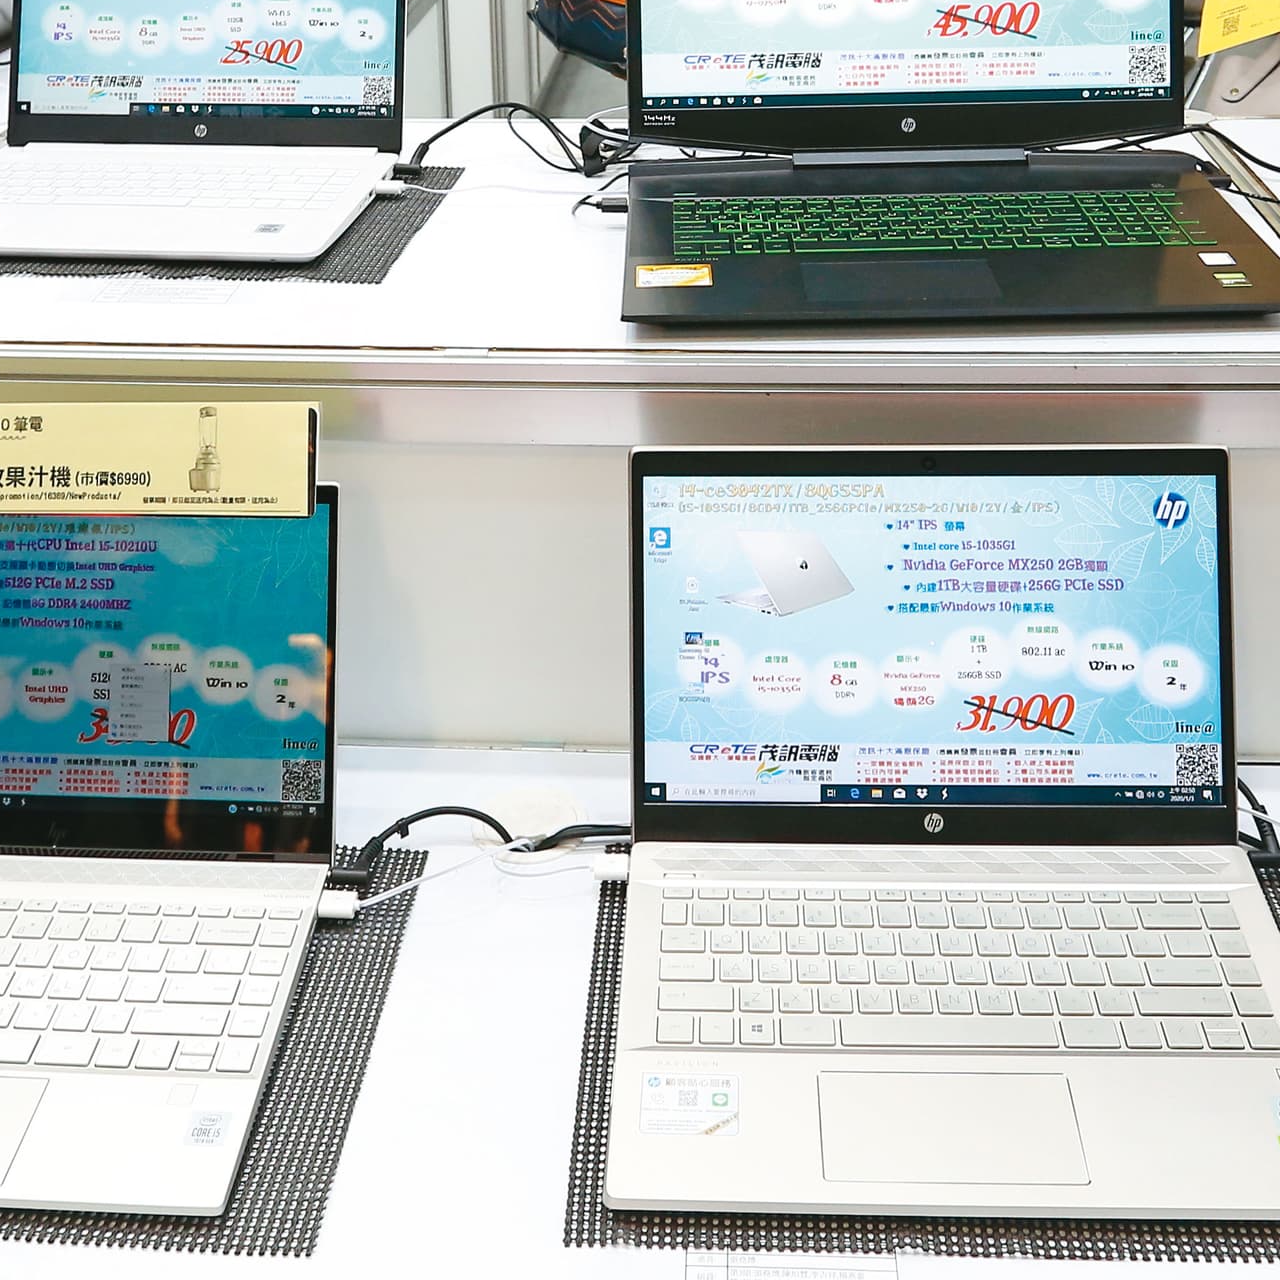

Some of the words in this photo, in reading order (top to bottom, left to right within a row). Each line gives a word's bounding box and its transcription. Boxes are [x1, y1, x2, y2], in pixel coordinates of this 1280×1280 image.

[1130, 30, 1165, 41] line@
[747, 52, 823, 69] 茂訊電腦
[194, 124, 208, 138] hp
[901, 118, 916, 132] hp
[13, 416, 44, 433] 筆電
[74, 470, 152, 489] (市價$6990)
[1153, 491, 1190, 530] hp
[918, 520, 937, 531] IPS
[64, 540, 95, 551] Intel
[913, 541, 937, 551] Intel
[939, 542, 960, 551] core
[903, 559, 946, 571] Nvidia
[950, 560, 1004, 571] GeForce
[1008, 560, 1054, 571] MX250
[35, 578, 62, 590] PCIe
[65, 578, 87, 590] M.2
[90, 578, 114, 590] SSD
[1064, 579, 1095, 592] PCIe
[1097, 579, 1124, 592] SSD
[48, 598, 78, 609] DDR4
[1021, 647, 1052, 656] 802.11
[1088, 660, 1117, 672] Win
[1121, 663, 1135, 671] 10
[700, 671, 730, 684] IPS
[752, 674, 773, 683] Intel
[777, 674, 801, 683] Core
[985, 671, 1002, 680] SSD
[25, 685, 46, 693] Intel
[48, 685, 68, 693] UHD
[206, 678, 232, 688] Win
[236, 680, 248, 688] 10
[1175, 722, 1215, 734] line@
[283, 738, 319, 750] line@
[758, 744, 840, 762] 茂訊電腦
[924, 812, 944, 833] hp
[192, 1128, 214, 1138] CORE
